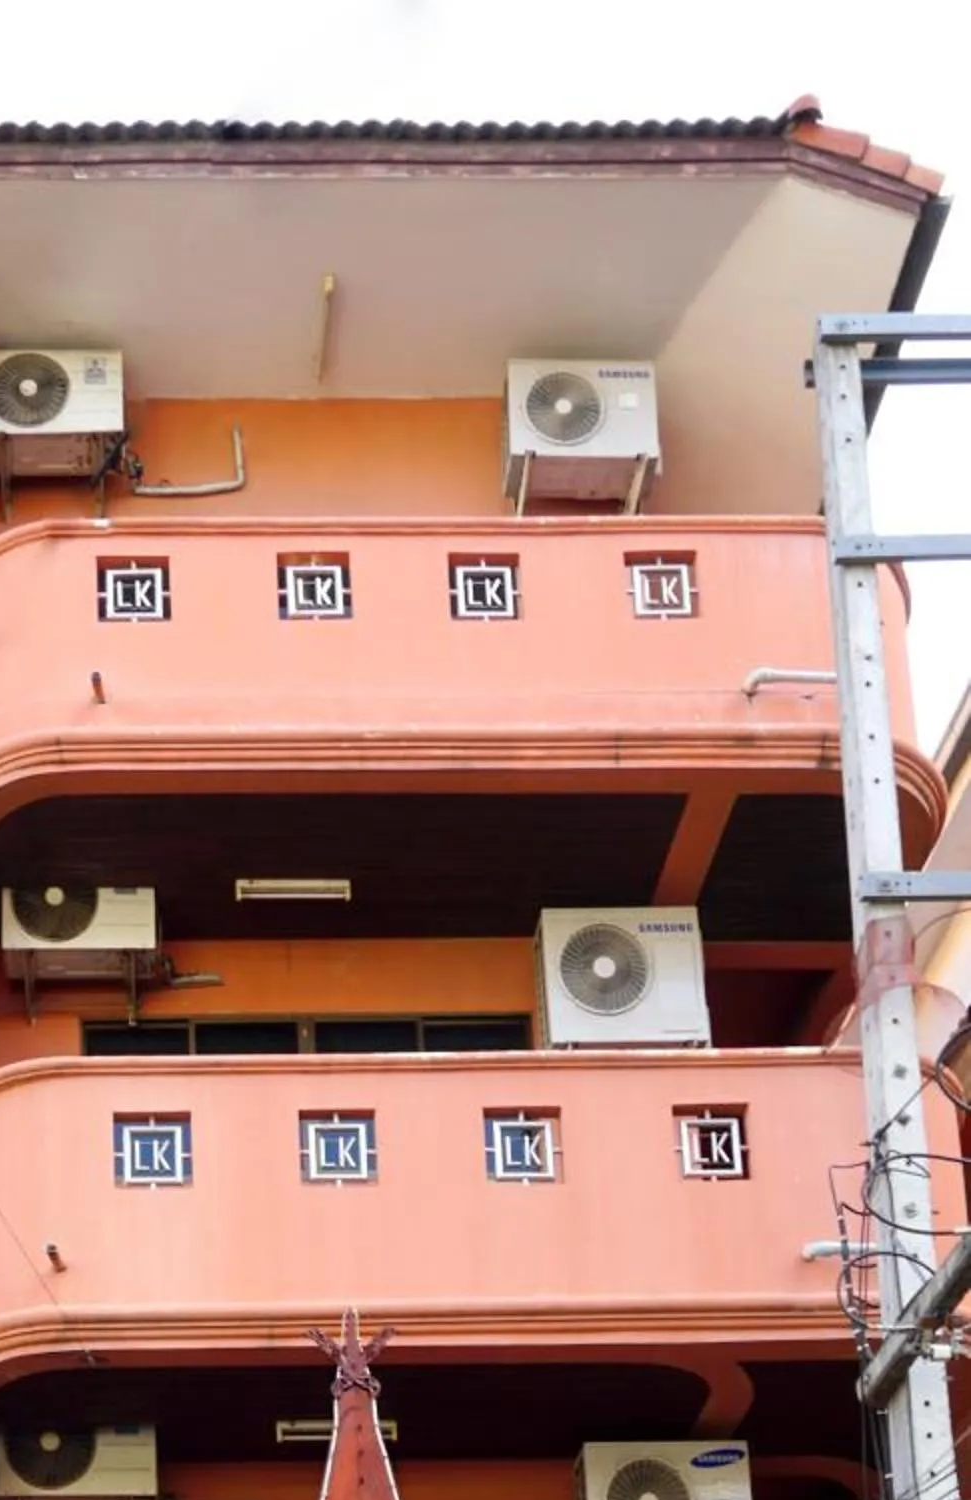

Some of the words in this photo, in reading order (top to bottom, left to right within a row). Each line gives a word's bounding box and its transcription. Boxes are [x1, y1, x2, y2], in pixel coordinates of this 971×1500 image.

[116, 579, 152, 607] LK
[297, 577, 334, 605] LK
[467, 577, 503, 606] LK
[644, 574, 680, 604] LK
[638, 921, 694, 933] SAMSUNG
[134, 1138, 172, 1170] LK
[319, 1135, 357, 1168] LK
[505, 1134, 542, 1166] LK
[692, 1131, 730, 1163] LK
